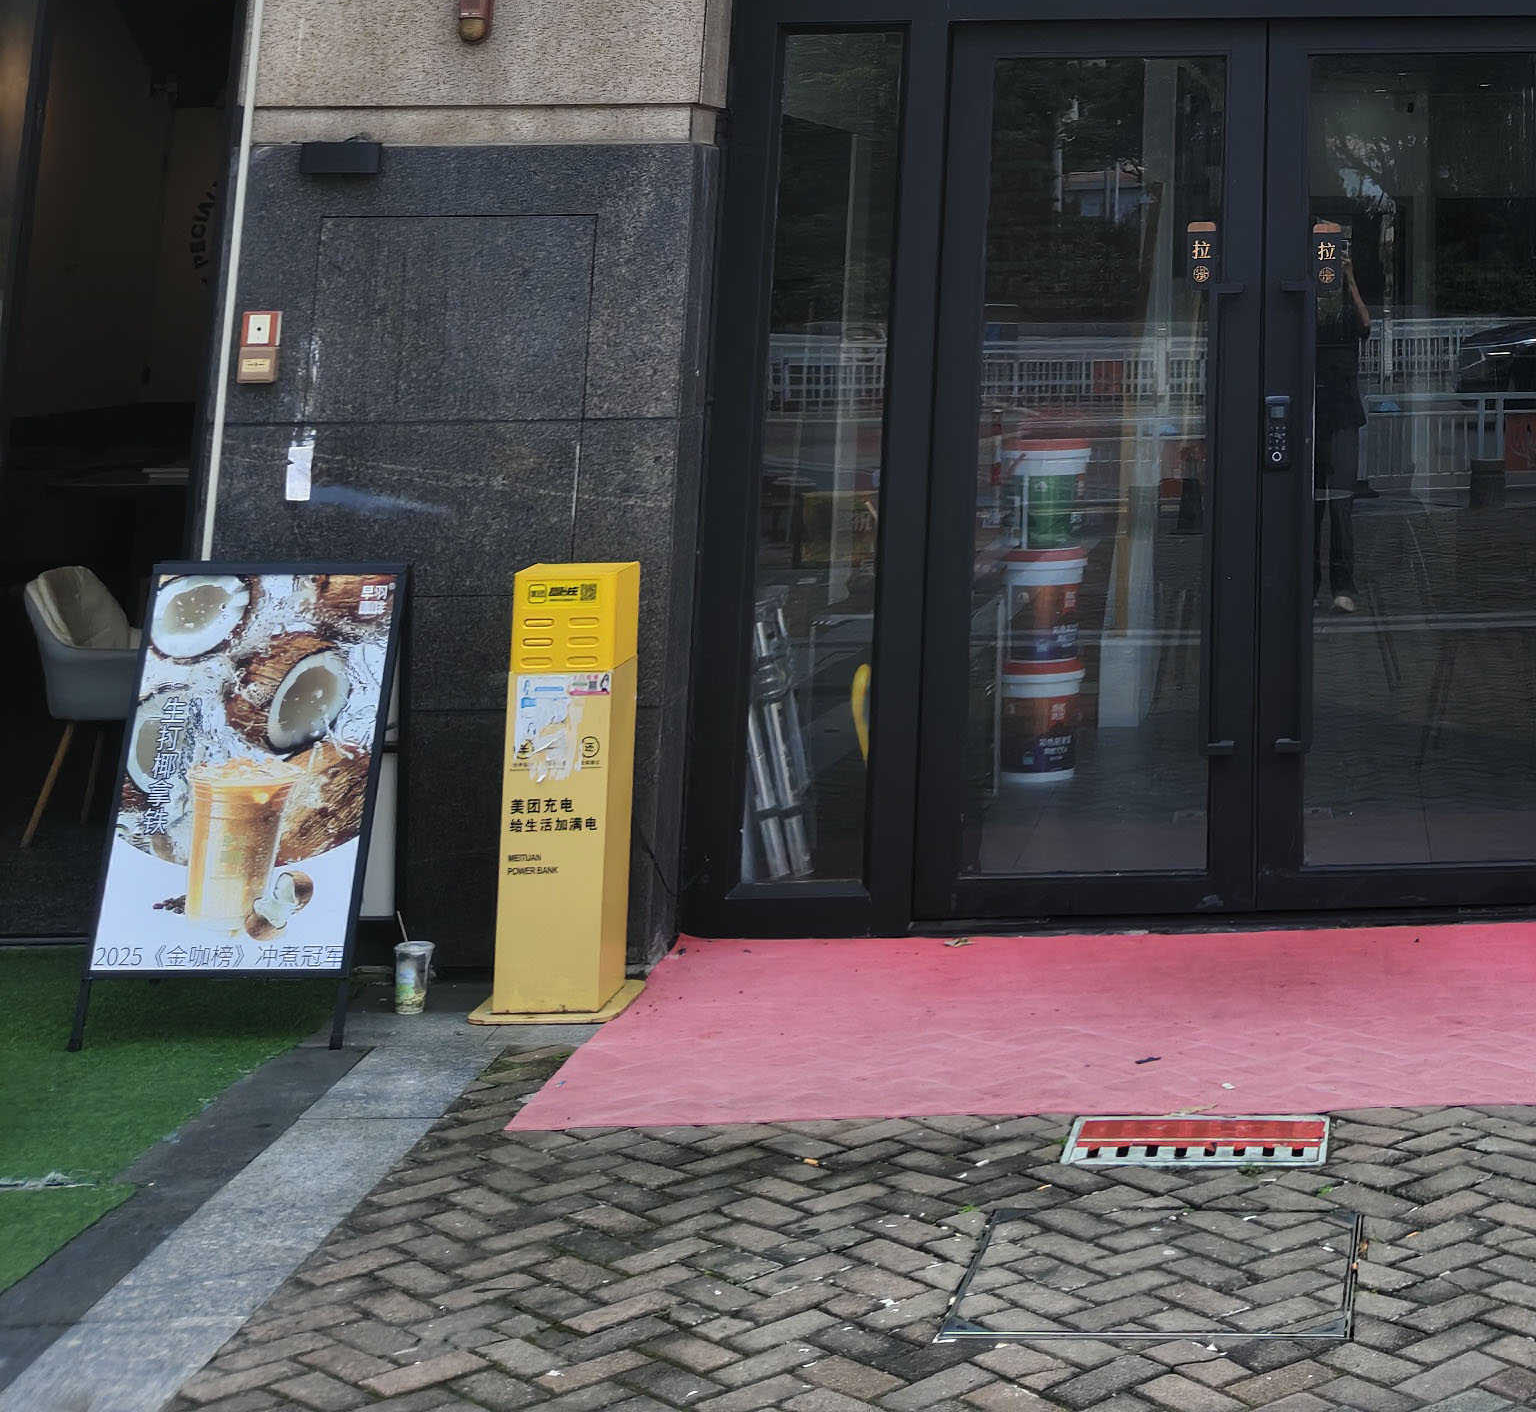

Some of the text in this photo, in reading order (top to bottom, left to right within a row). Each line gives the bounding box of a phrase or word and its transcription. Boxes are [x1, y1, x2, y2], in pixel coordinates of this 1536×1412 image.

[1191, 240, 1211, 260] 拉
[1317, 241, 1336, 261] 拉
[143, 696, 187, 835] 生打椰拿铁
[510, 797, 574, 814] 美团充电
[509, 817, 598, 833] 给生活加满电
[507, 853, 542, 863] MEITUAN
[507, 866, 559, 876] POWER BANK
